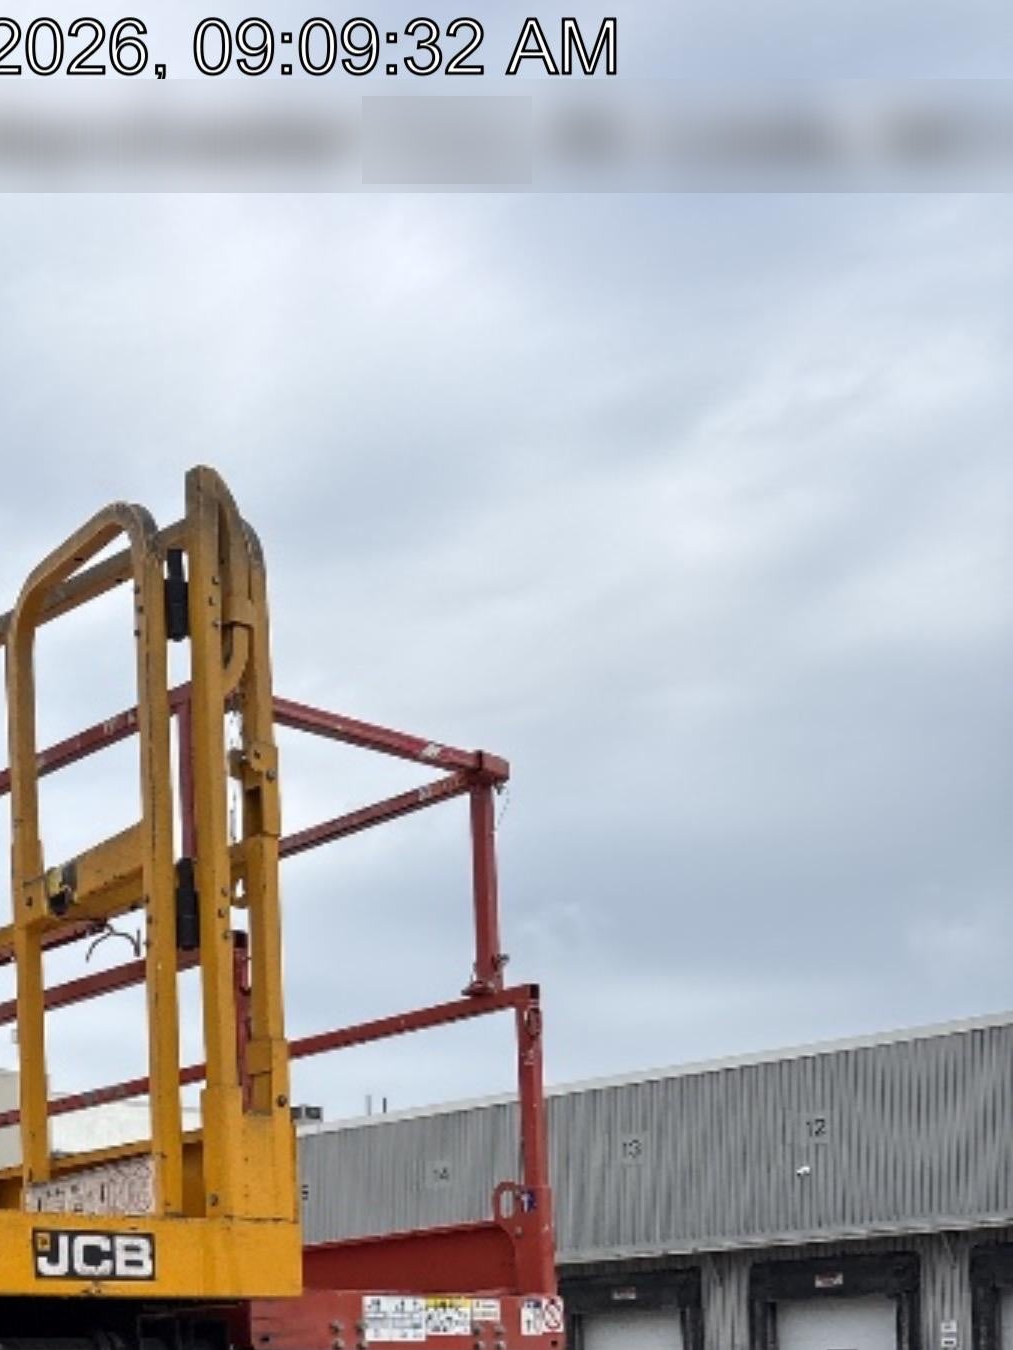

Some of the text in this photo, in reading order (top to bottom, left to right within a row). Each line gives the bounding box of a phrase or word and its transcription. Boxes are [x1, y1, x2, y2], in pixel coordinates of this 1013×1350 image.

[805, 1118, 826, 1137] 12
[622, 1138, 641, 1159] 13
[37, 1234, 153, 1276] JCB
